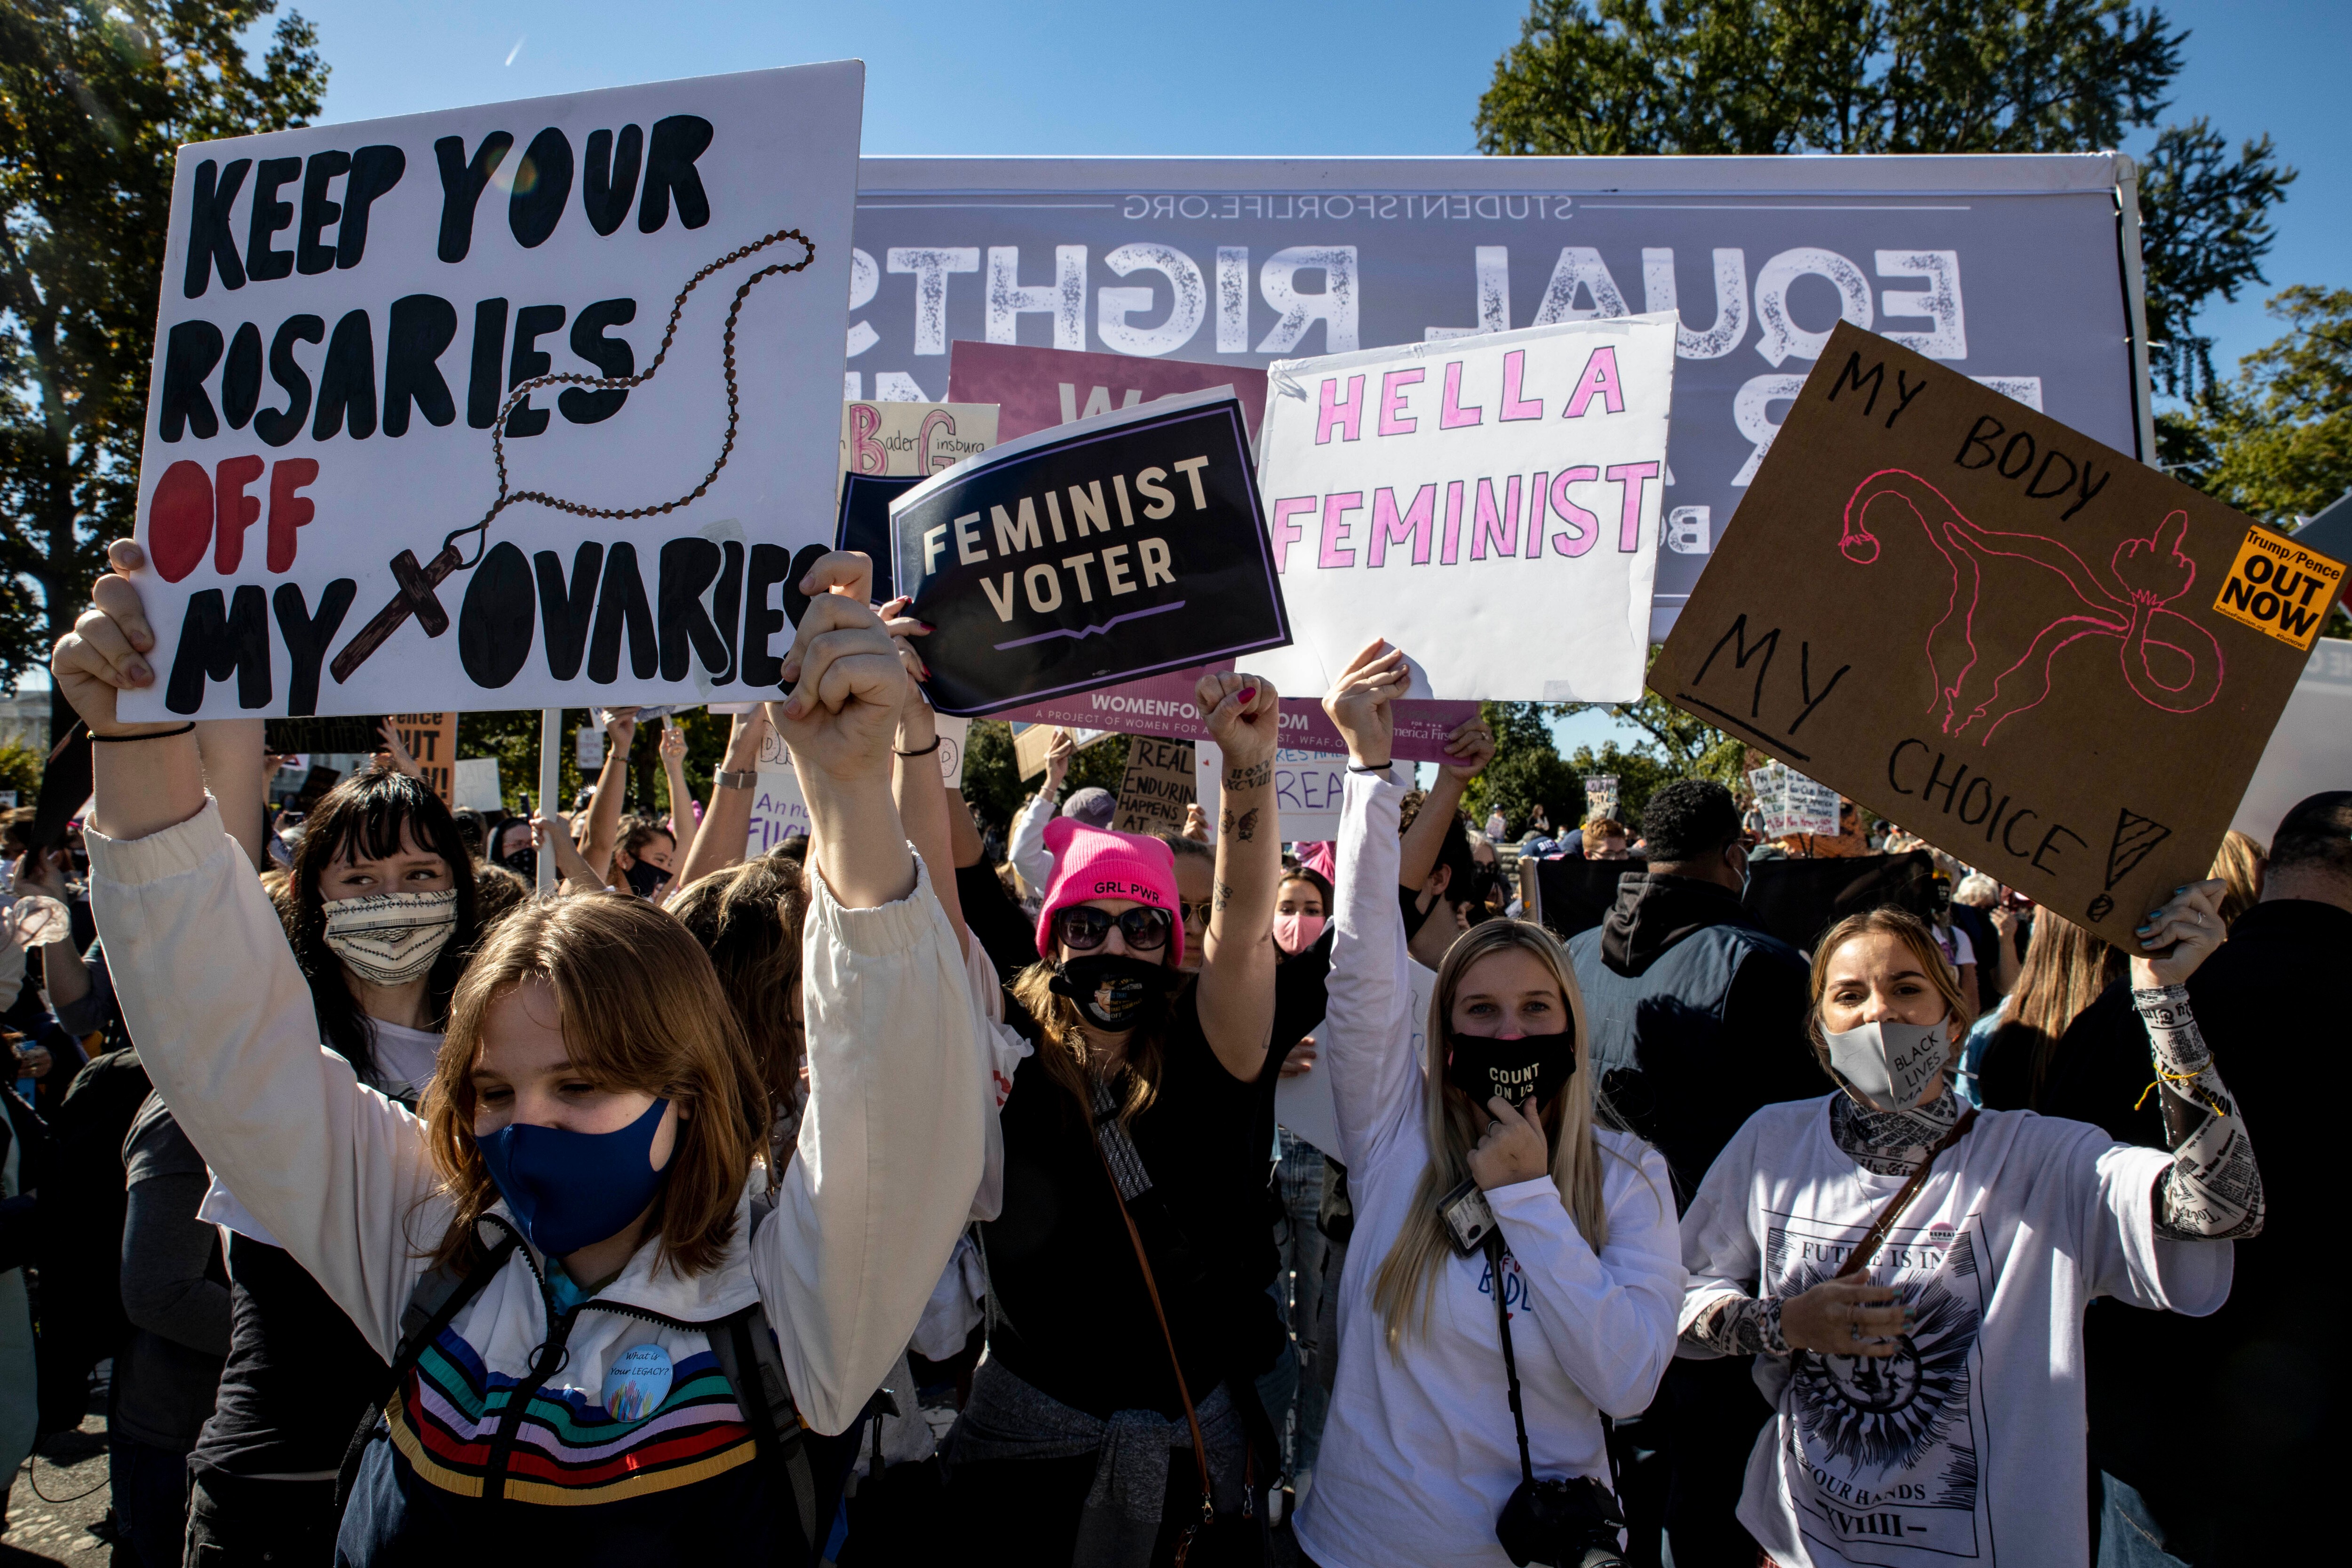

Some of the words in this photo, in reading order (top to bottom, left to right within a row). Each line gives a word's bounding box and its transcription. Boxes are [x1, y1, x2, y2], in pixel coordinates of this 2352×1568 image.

[184, 145, 406, 299] KEEP
[434, 114, 715, 263] YOUR
[159, 293, 637, 448] ROSARIES
[1315, 345, 1626, 446] HELLA
[849, 403, 920, 477] Bader
[1827, 350, 1927, 429] MY
[1954, 414, 2111, 522] BODY
[148, 454, 320, 584] OFF
[923, 454, 1210, 576] FEMINIST
[1271, 460, 1661, 574] FEMINIST
[2247, 529, 2340, 580] Trump/Pence
[979, 537, 1176, 622] VOTER
[2244, 554, 2326, 606] OUT
[165, 577, 357, 717] MY
[458, 537, 834, 696] OVARIES
[2215, 605, 2267, 632] RefuseFascism.org
[2221, 576, 2320, 637] NOW
[1692, 613, 1851, 735] MY
[1035, 709, 1042, 718] A
[1048, 710, 1099, 724] PROJECT
[1104, 716, 1120, 725] OF
[1125, 719, 1169, 731] WOMEN
[1174, 723, 1197, 734] FOR
[1278, 733, 1294, 744] ST,
[1300, 735, 1348, 748] WFAF.O
[1393, 727, 1429, 740] merica
[1431, 728, 1450, 741] Firs
[1276, 749, 1308, 762] KES
[1123, 767, 1197, 804] ENDURIN
[1275, 771, 1344, 809] REA
[1118, 794, 1179, 821] HAPPENS
[1094, 881, 1127, 894] GRL
[1130, 883, 1160, 904] PWR
[2140, 1008, 2175, 1026] Tim
[1894, 1030, 1939, 1072] BLACK
[1905, 1051, 1940, 1088] LIVES
[1489, 1062, 1540, 1084] COUNT
[1494, 1083, 1512, 1100] ON
[1520, 1081, 1534, 1098] US
[1802, 1241, 1883, 1266] FUTE
[1891, 1250, 1912, 1268] IS
[610, 1367, 631, 1376] Your
[632, 1367, 669, 1377] LEGACY?
[625, 1351, 648, 1361] What
[650, 1351, 660, 1361] is
[1809, 1464, 1852, 1500] YOUR
[1855, 1484, 1926, 1505] HANDS
